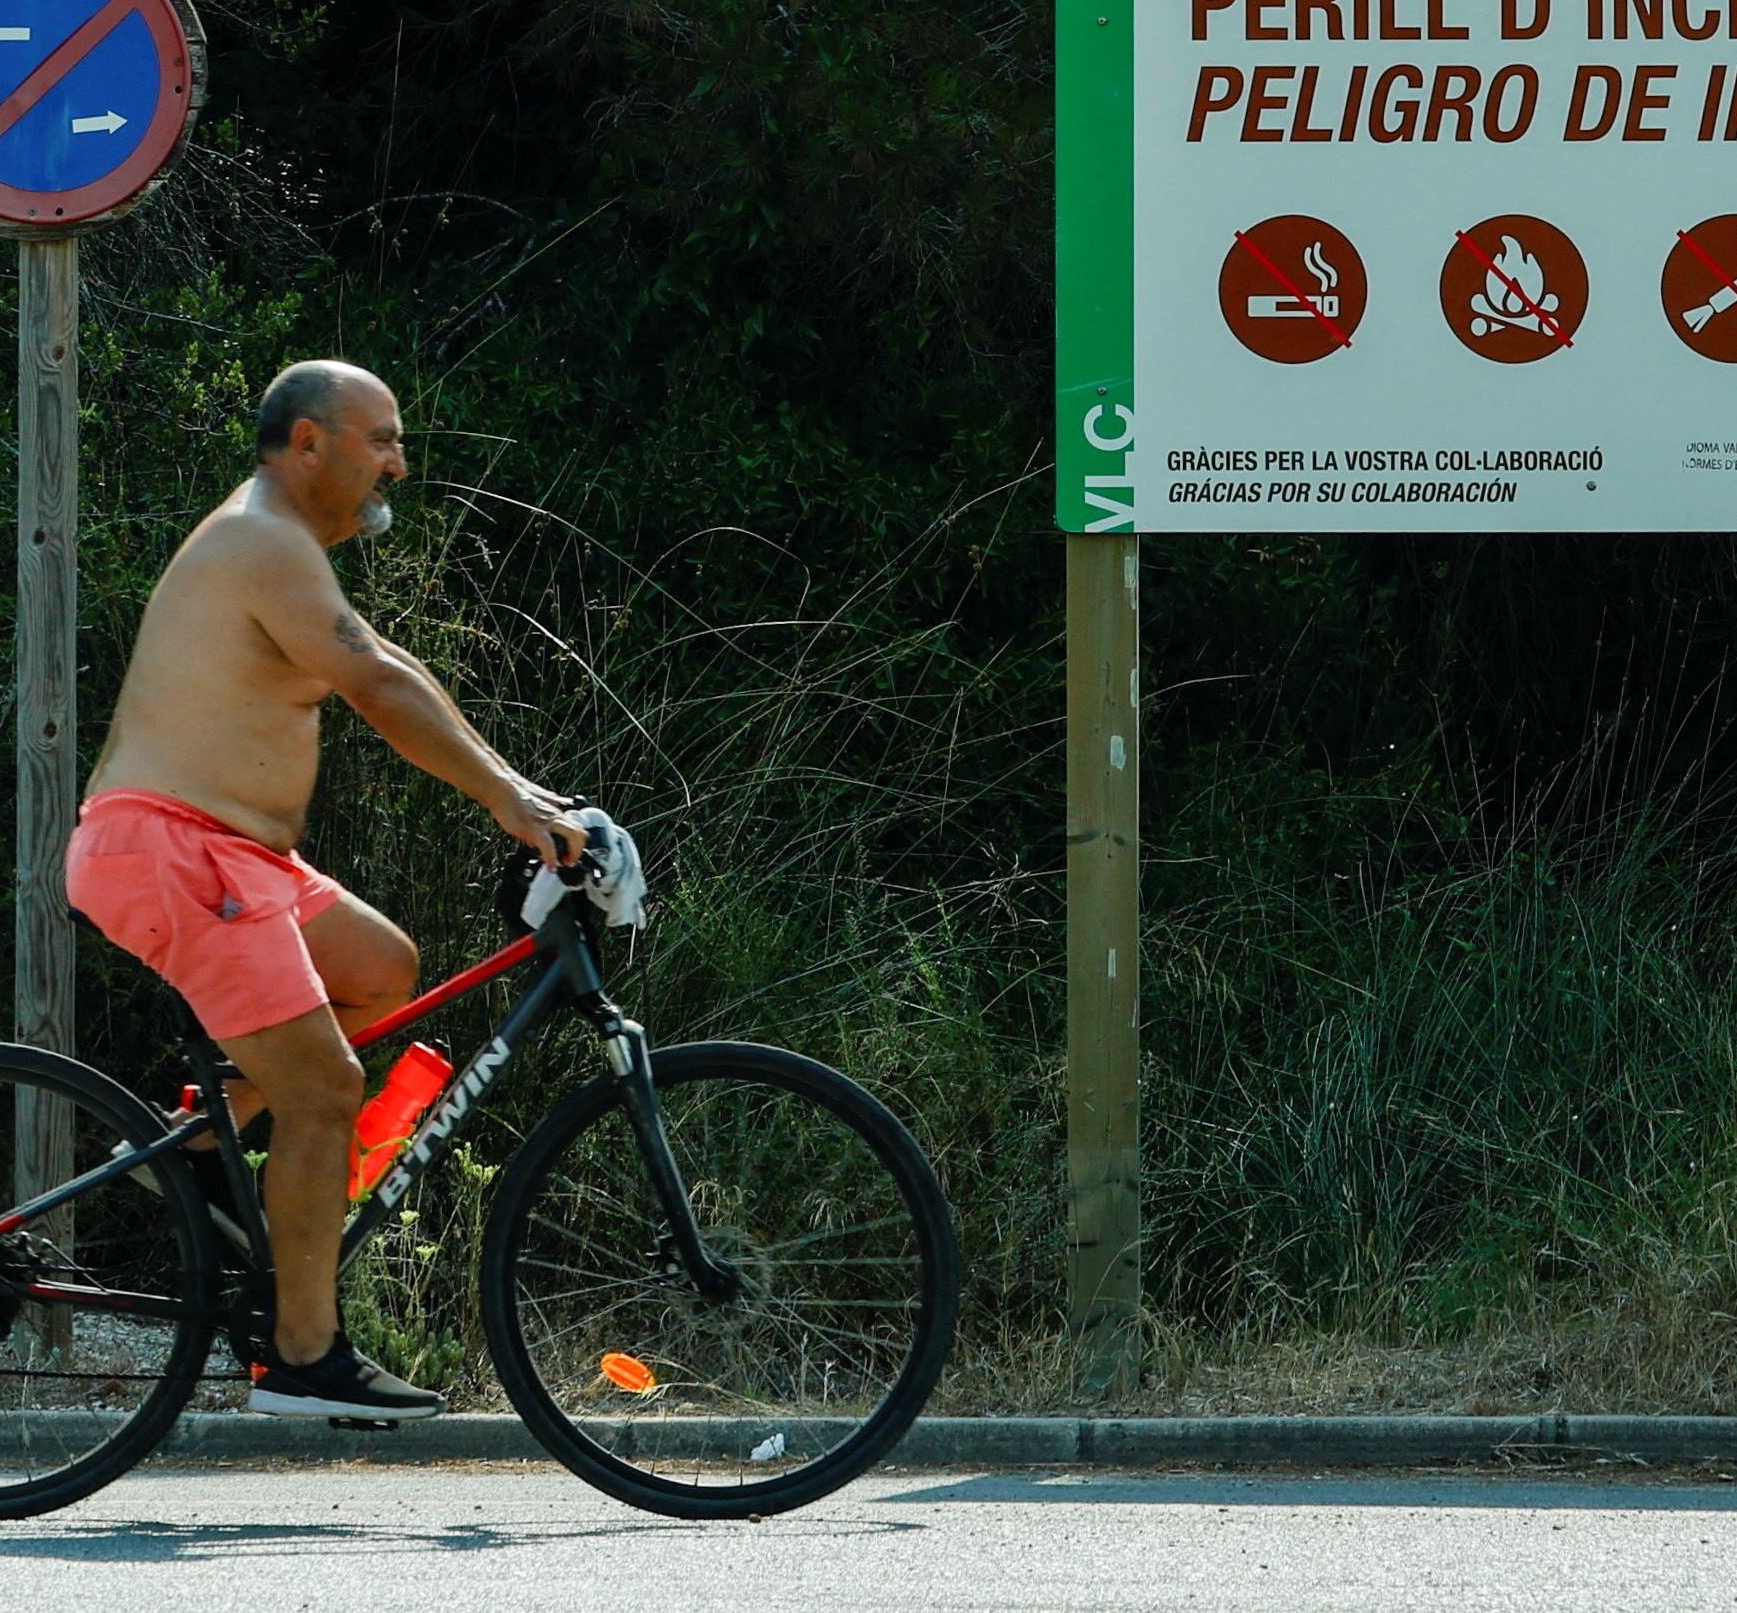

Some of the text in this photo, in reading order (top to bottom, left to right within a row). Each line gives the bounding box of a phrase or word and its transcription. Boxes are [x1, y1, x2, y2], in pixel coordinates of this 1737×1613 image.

[1185, 63, 1540, 144] PELIGRO
[1563, 64, 1679, 142] DE
[1083, 403, 1136, 533] VLC
[1167, 445, 1258, 472] GRÀCIES
[1264, 450, 1305, 472] PER
[1311, 450, 1339, 471] LA
[1344, 450, 1429, 472] VOSTRA
[1168, 477, 1518, 504] GRÁCIAS POR SU COLABORACIÓN
